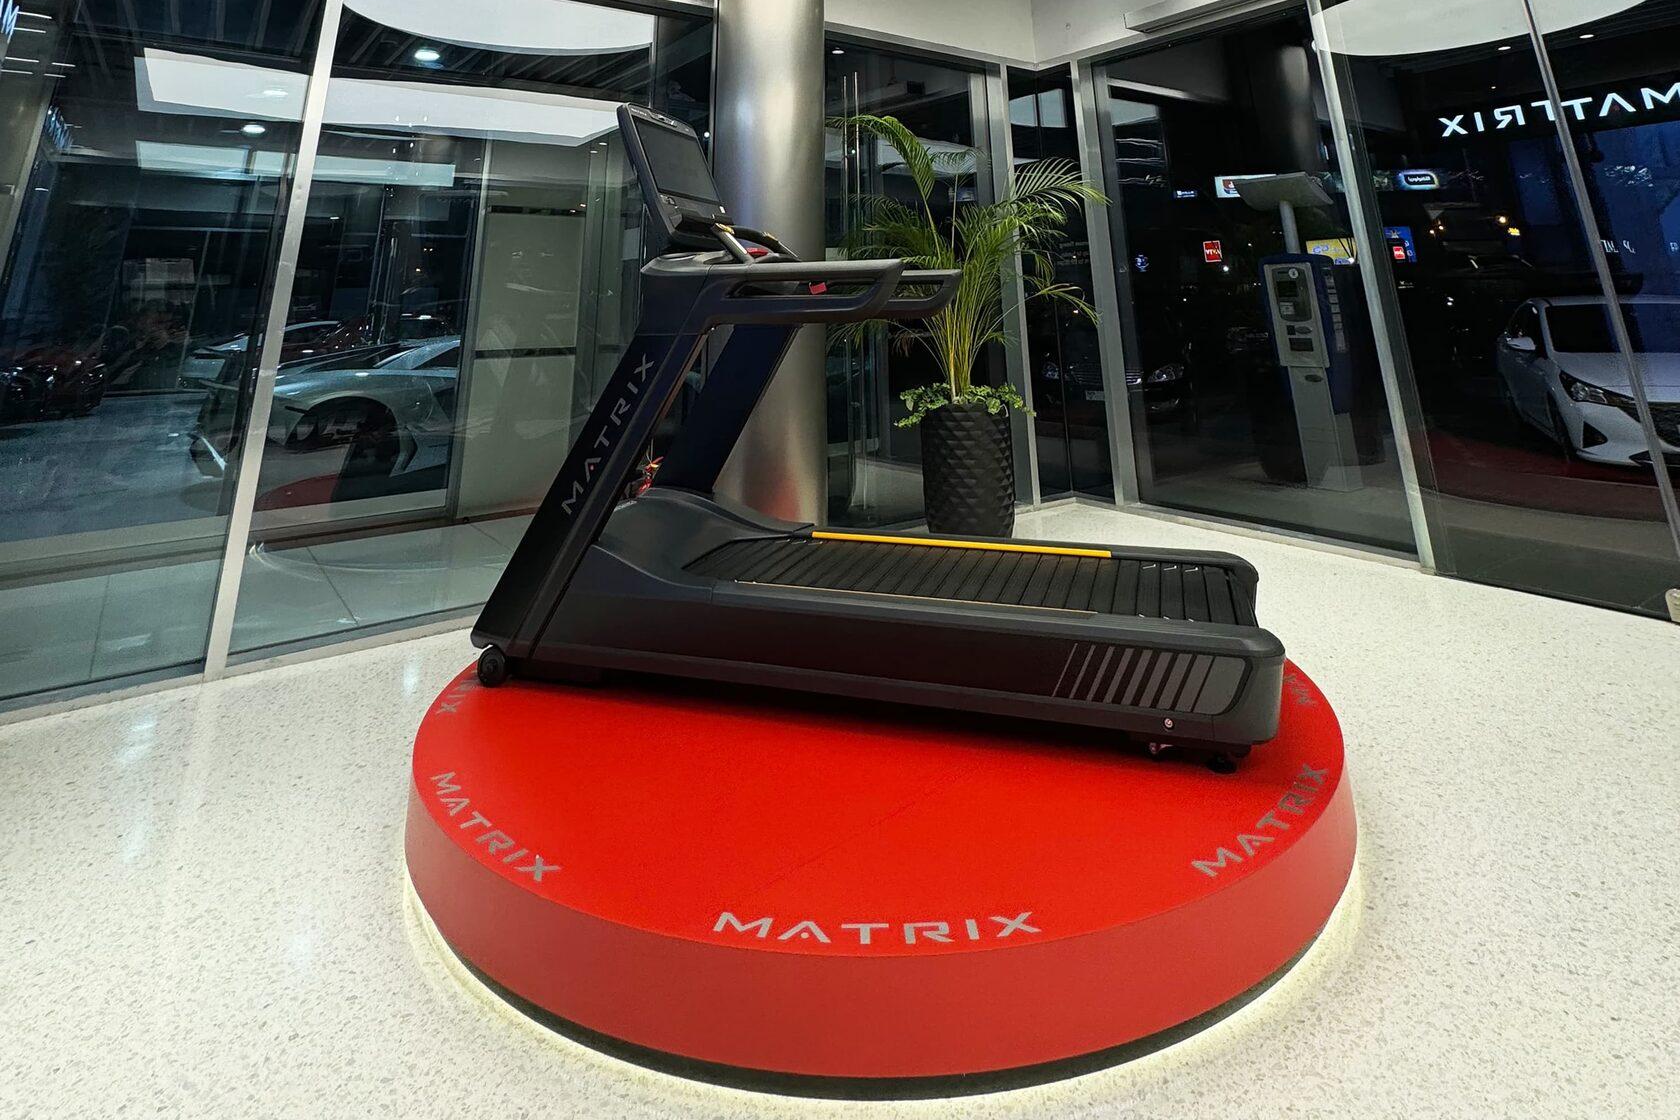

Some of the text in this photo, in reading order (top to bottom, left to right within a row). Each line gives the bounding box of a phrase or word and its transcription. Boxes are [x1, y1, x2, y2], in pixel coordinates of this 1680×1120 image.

[561, 352, 655, 515] MATRIX
[429, 771, 562, 883] MATRIX
[1191, 763, 1328, 878] MATRIX
[712, 911, 1042, 945] MATRIX
